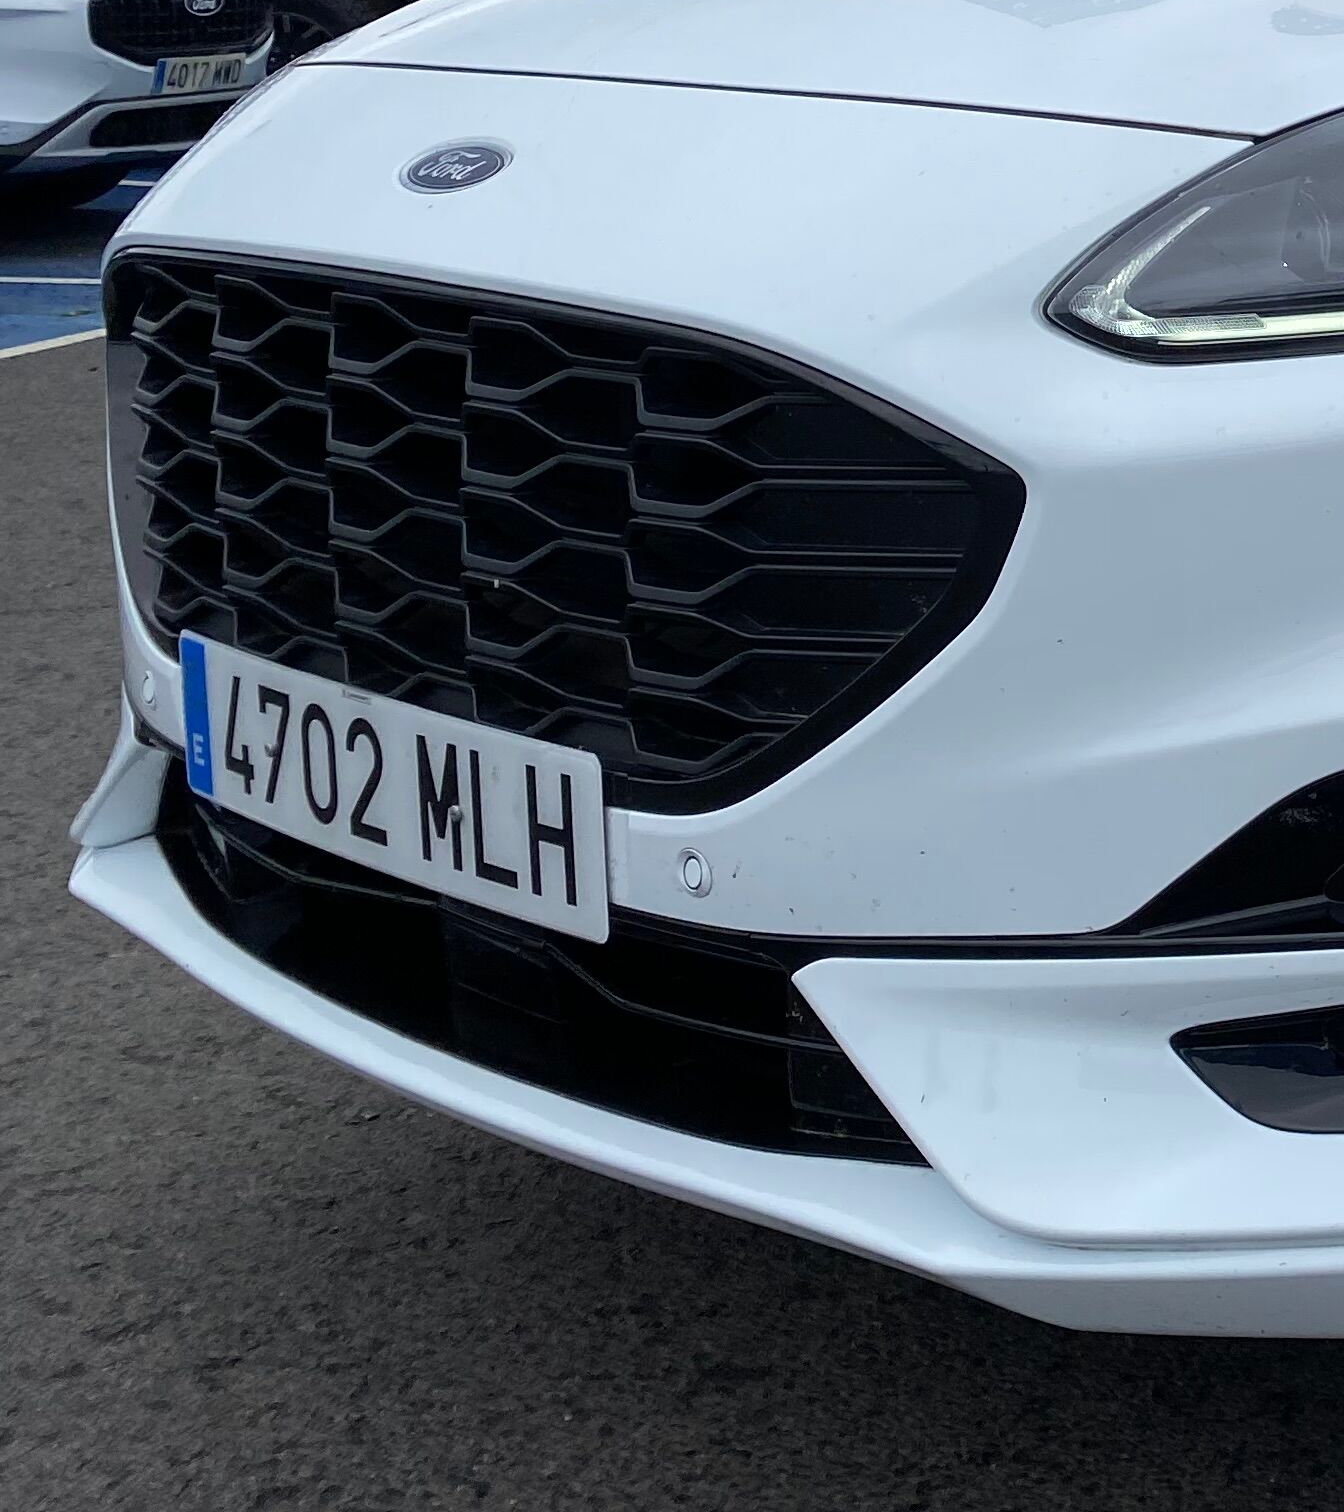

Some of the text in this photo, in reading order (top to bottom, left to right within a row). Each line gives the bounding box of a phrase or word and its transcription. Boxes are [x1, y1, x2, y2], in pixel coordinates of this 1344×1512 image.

[418, 150, 487, 181] Ford
[192, 675, 578, 908] E 4702 MLH
